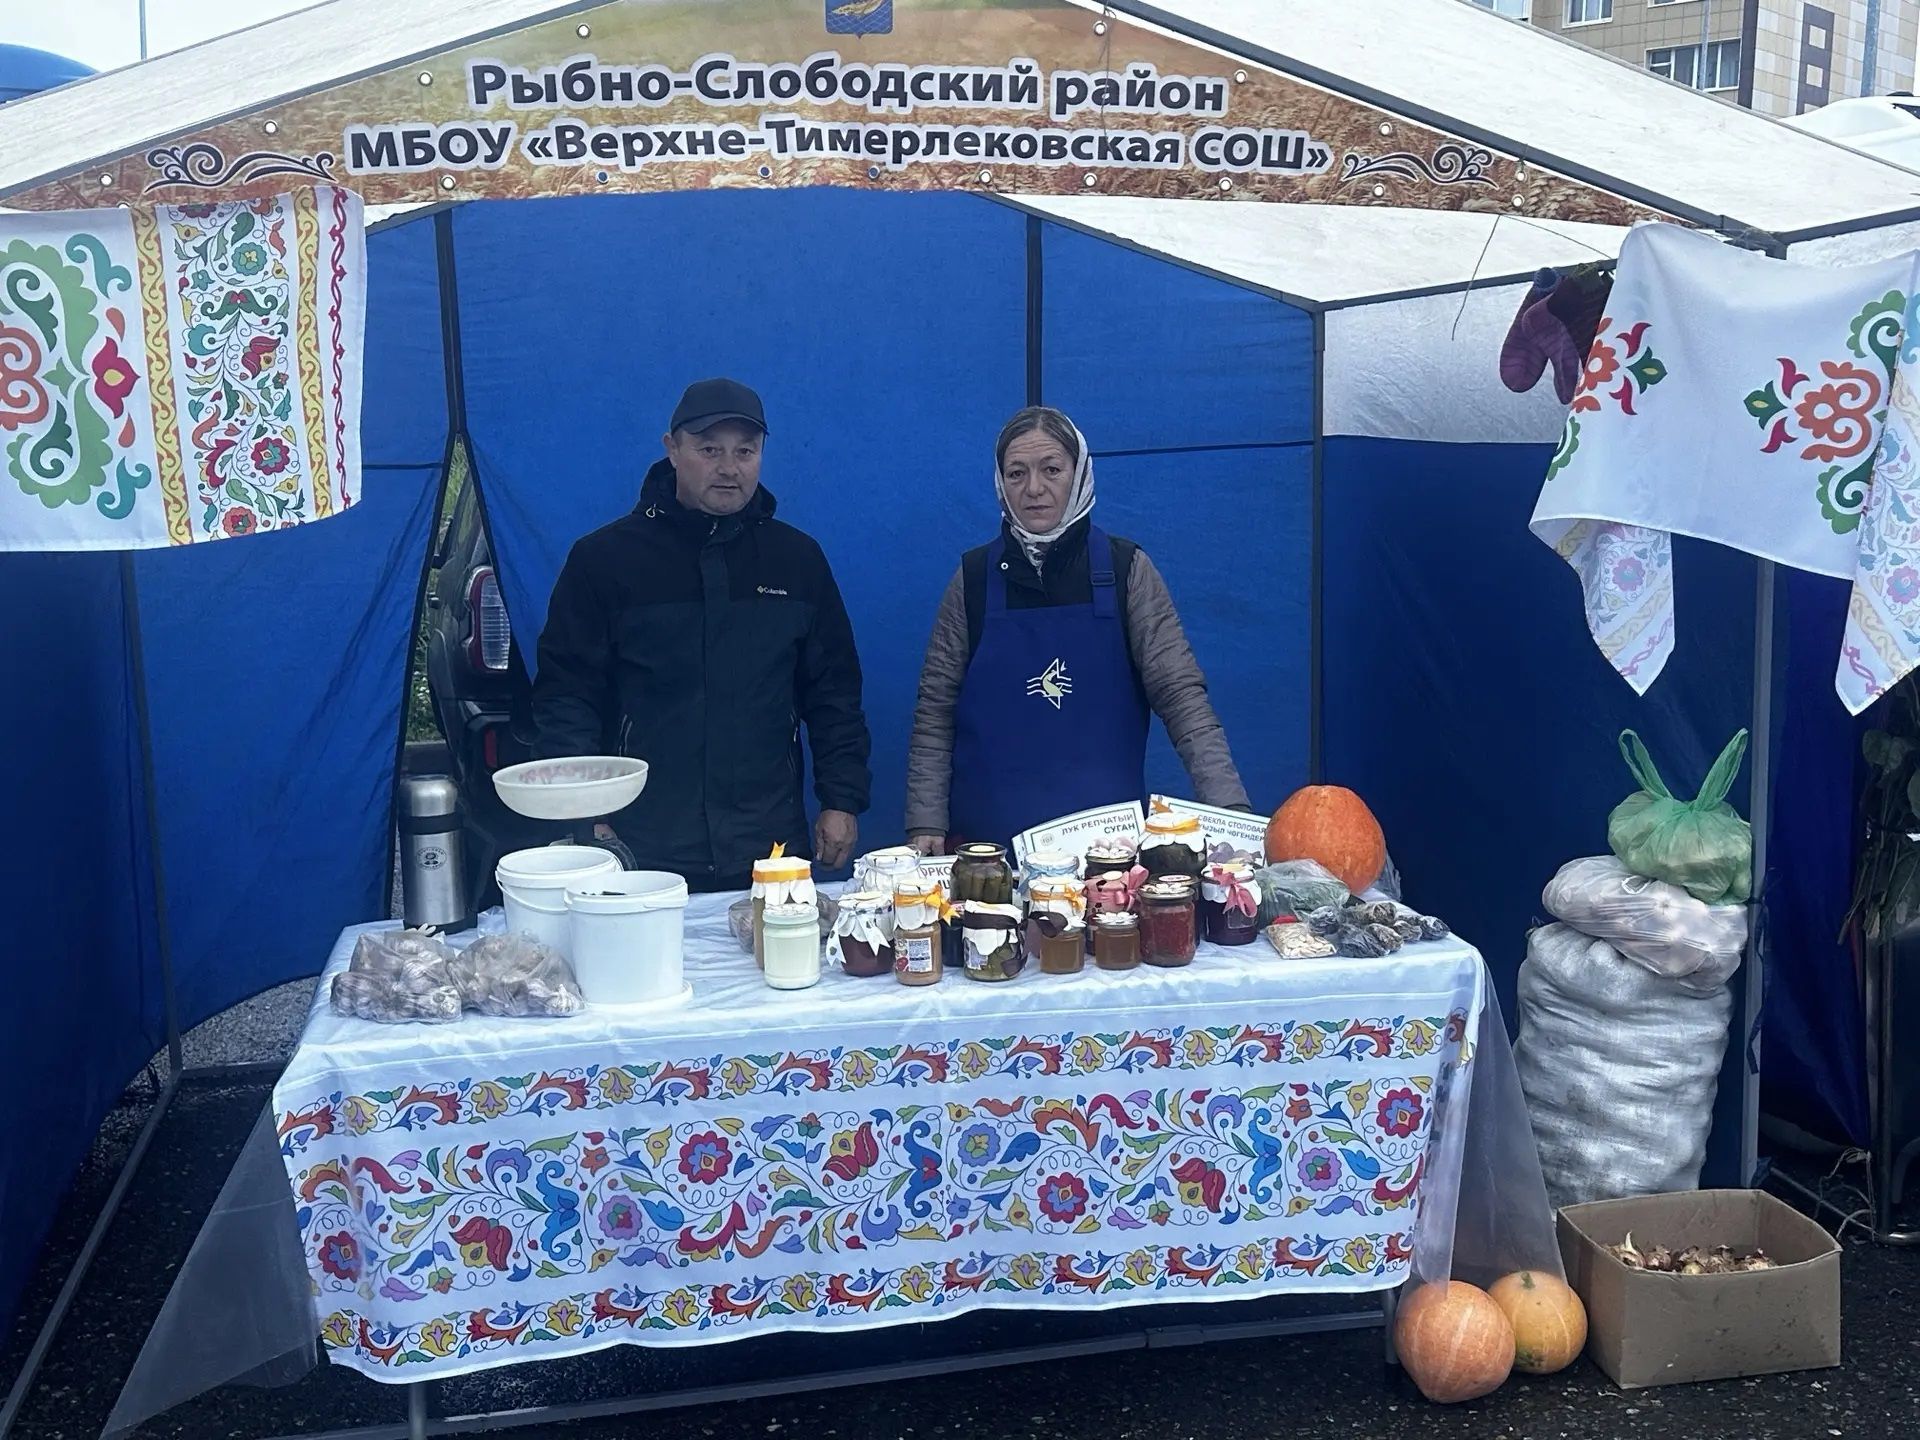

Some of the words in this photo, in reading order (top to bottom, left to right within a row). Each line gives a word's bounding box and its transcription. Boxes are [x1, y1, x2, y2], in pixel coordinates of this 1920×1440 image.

[472, 59, 1038, 108] Рыбно-Слободский
[1055, 66, 1223, 115] район
[351, 126, 511, 168] МБОУ
[527, 119, 1181, 168] «Верхне-Тимерлековская
[1194, 133, 1330, 170] СОШ»
[1062, 825, 1080, 836] ЛУК
[1081, 813, 1134, 830] РЕПЧАТЫЙ
[1104, 822, 1136, 835] СУГАН
[1198, 814, 1227, 826] СВЕКЛА
[1228, 821, 1266, 834] СТОЛОВАЯ
